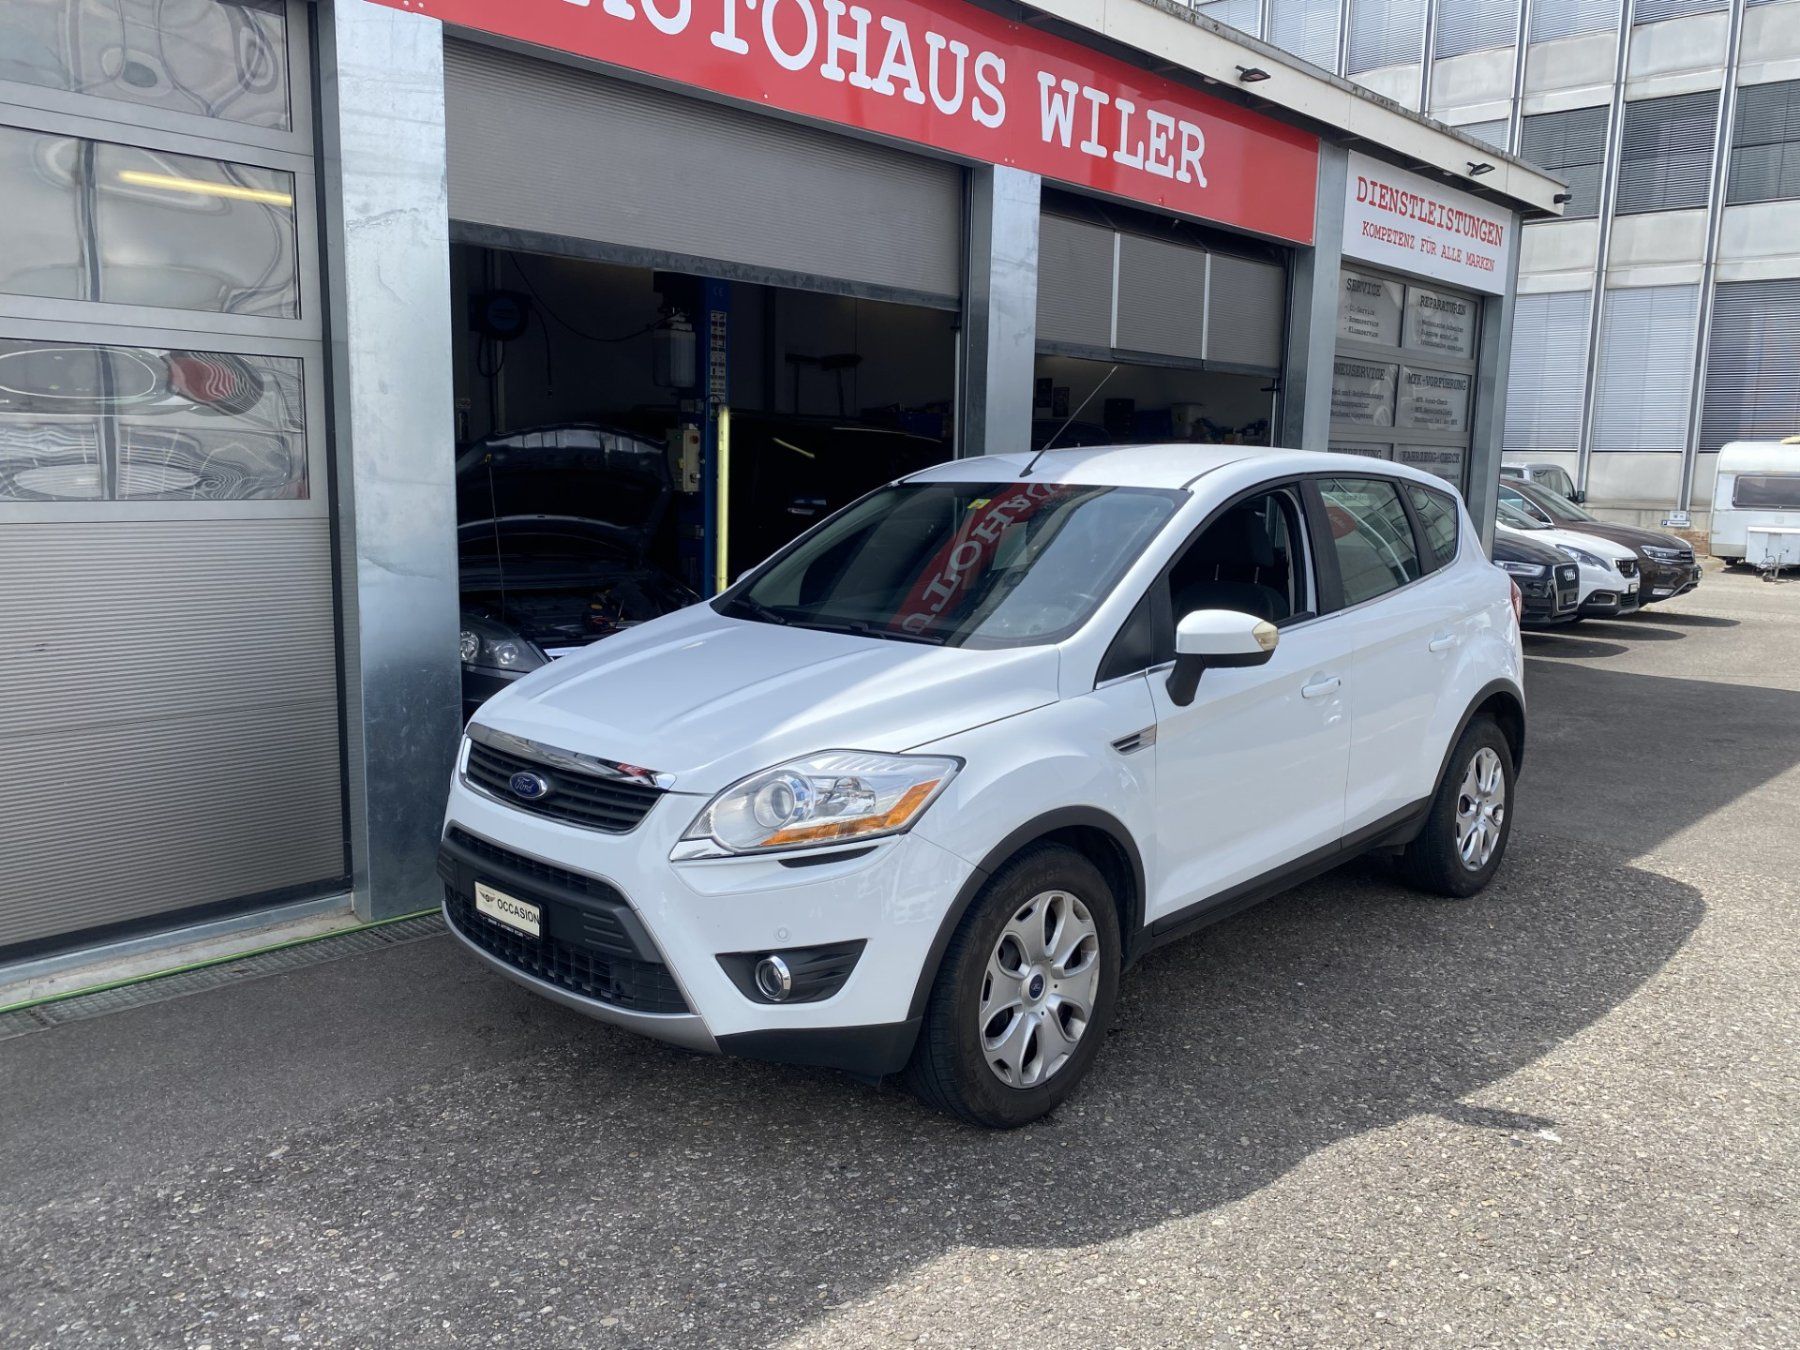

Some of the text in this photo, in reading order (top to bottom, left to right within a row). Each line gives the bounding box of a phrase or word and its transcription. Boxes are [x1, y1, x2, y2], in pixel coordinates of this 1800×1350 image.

[1037, 70, 1208, 188] WILER
[1356, 176, 1504, 247] DIENSTLEISTUNGEN
[1362, 220, 1496, 273] KOMPETENZ FÜR ALLE MARKEN
[1346, 278, 1382, 297] SERVICE
[513, 776, 535, 793] Ford
[497, 898, 540, 924] OCCASION
